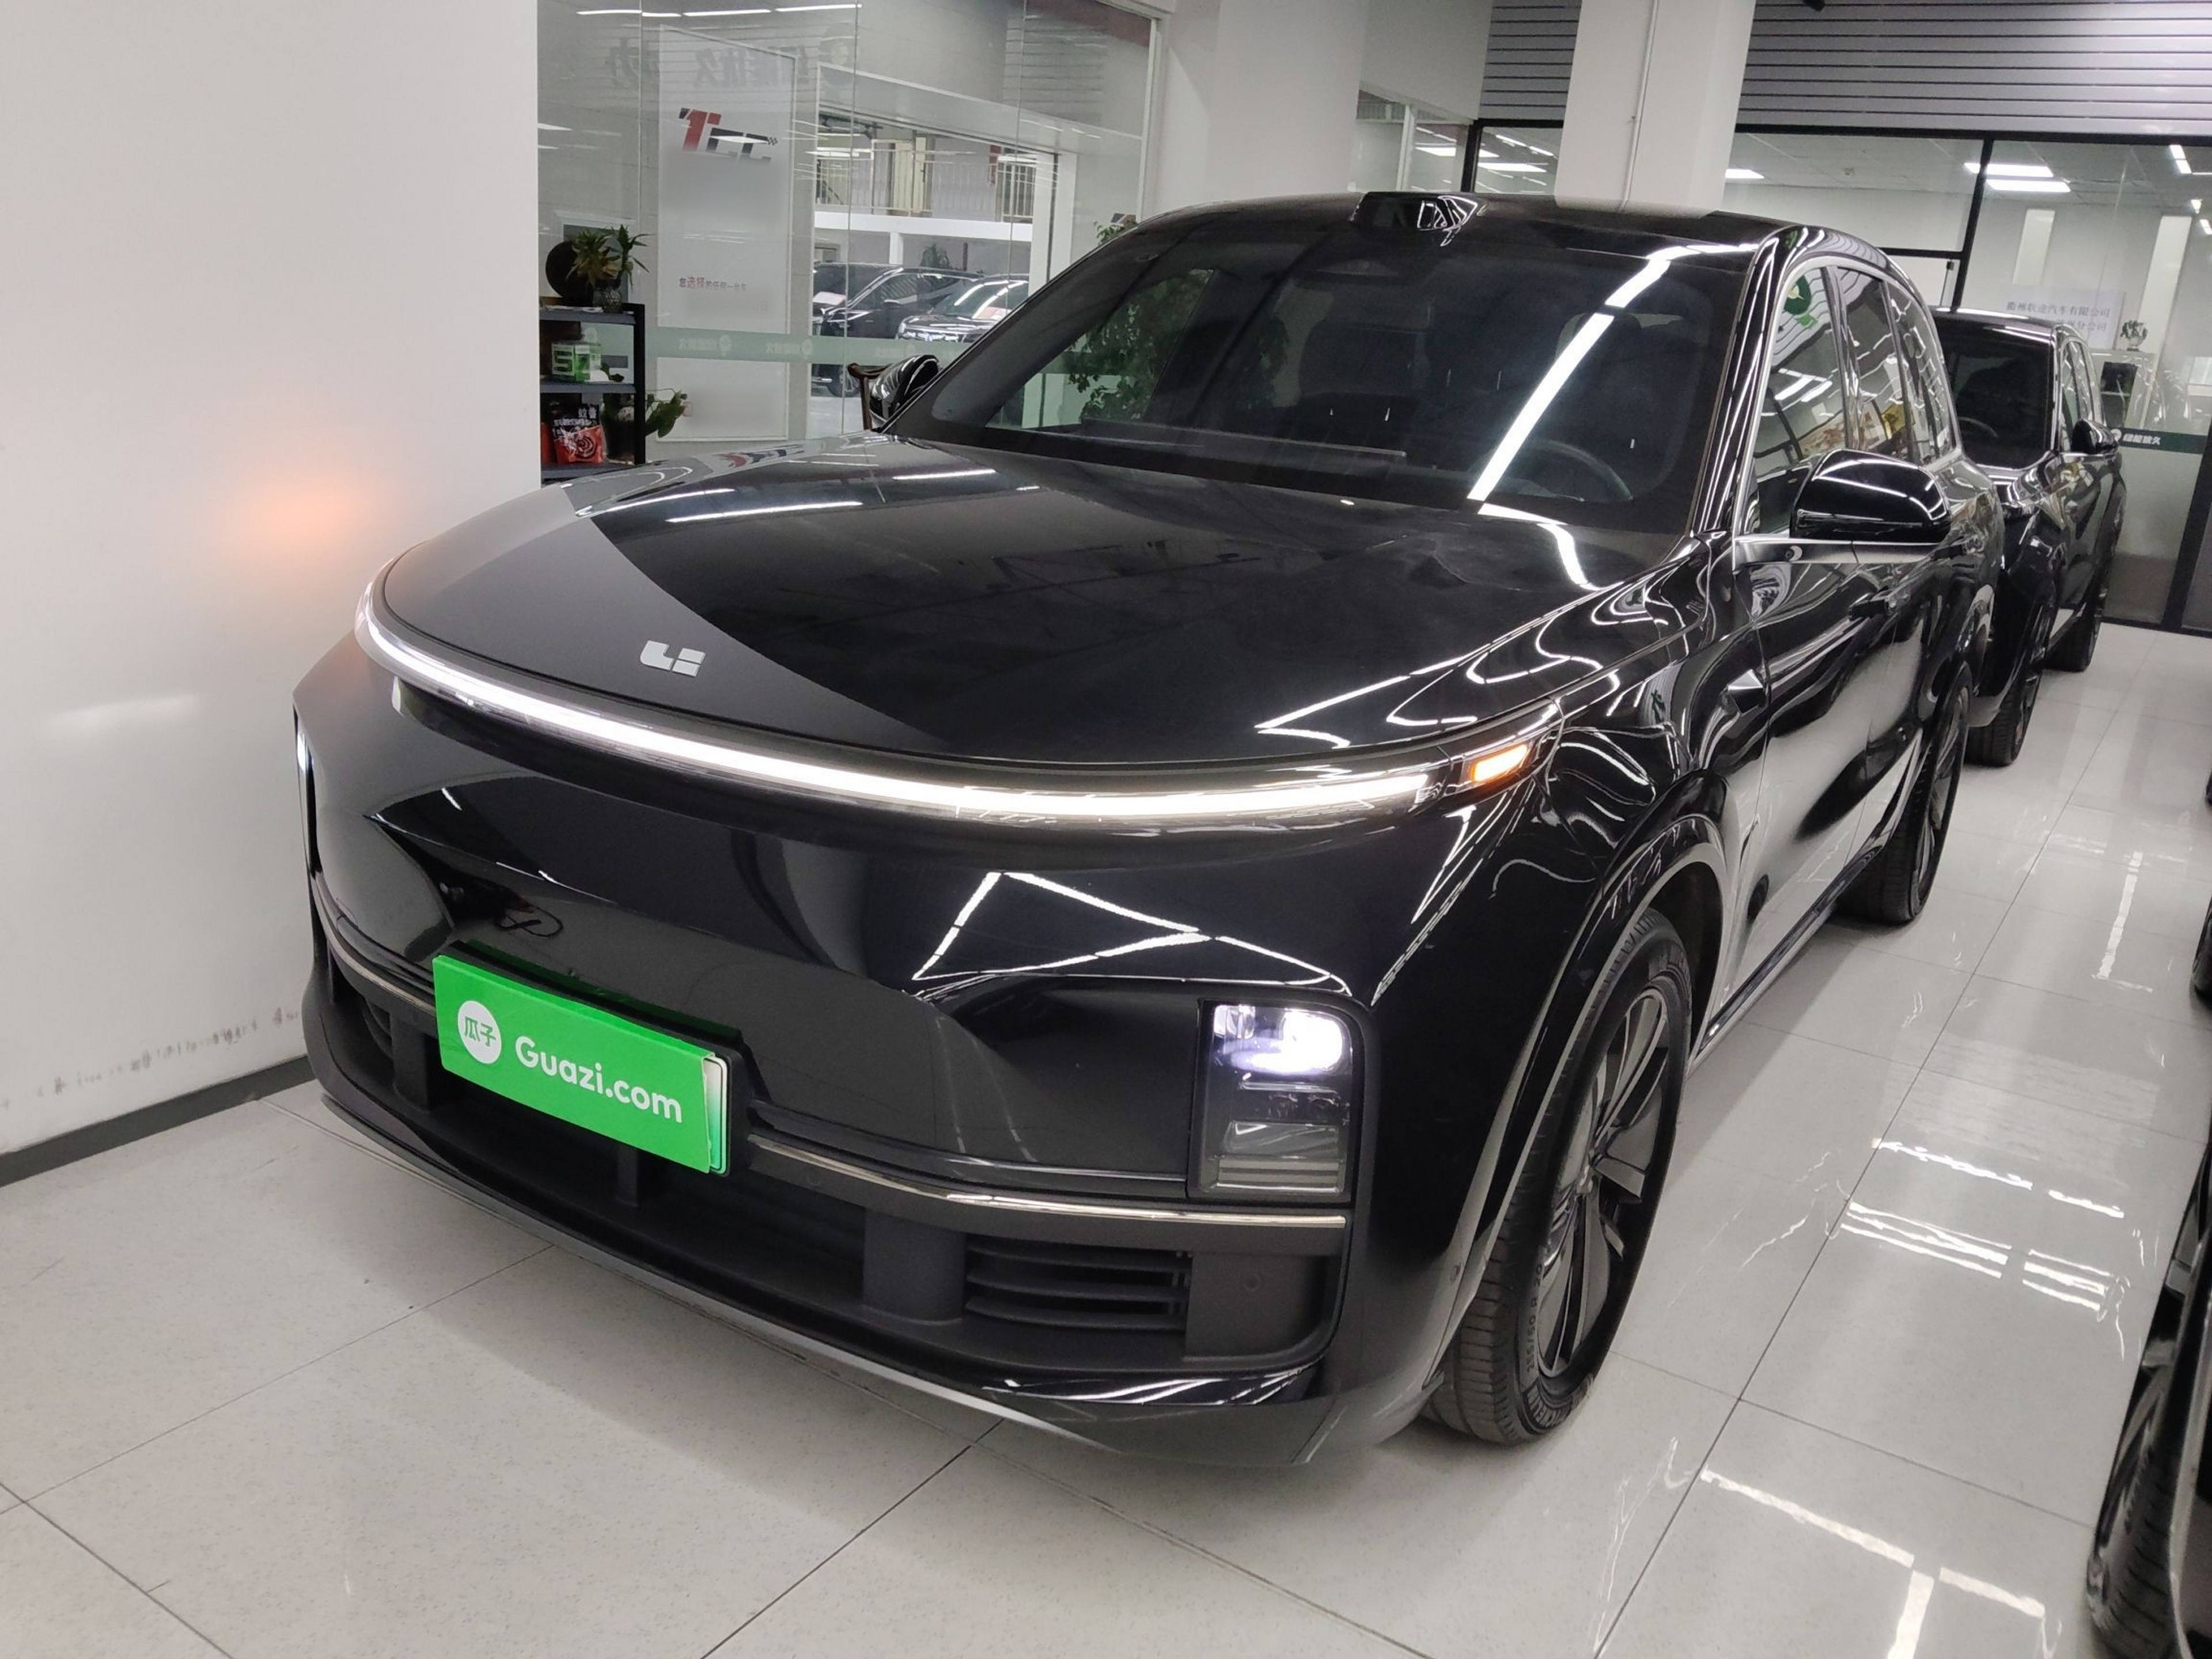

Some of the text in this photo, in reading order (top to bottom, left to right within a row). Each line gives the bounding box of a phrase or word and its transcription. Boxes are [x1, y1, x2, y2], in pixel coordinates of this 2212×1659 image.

[463, 1016, 497, 1047] 瓜子
[515, 1035, 682, 1124] Guazi.com
[1527, 1384, 1572, 1429] ICHELIN
